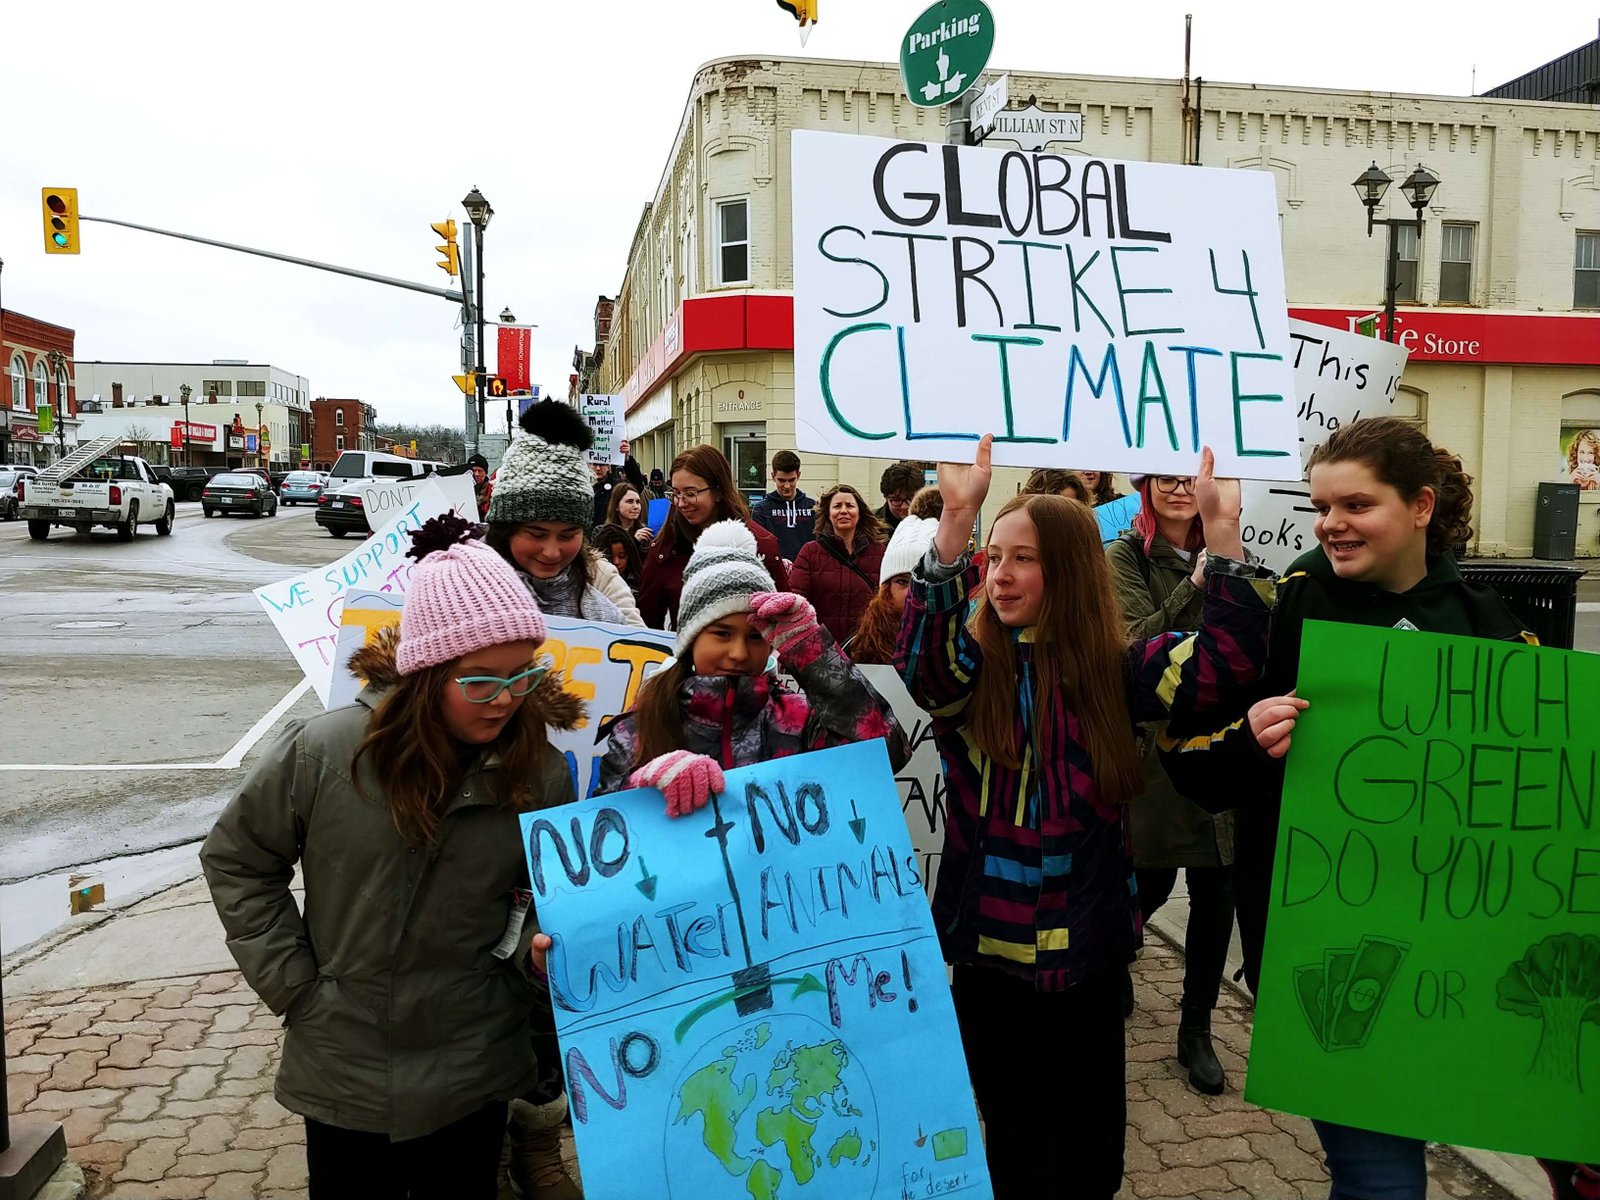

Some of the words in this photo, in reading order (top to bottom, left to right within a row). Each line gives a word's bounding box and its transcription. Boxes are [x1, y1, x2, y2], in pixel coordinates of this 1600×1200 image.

[908, 12, 981, 55] Parking
[975, 94, 992, 121] KENT
[996, 117, 1046, 134] ILLIAM
[1049, 119, 1066, 135] ST
[1069, 119, 1079, 135] N
[873, 142, 1172, 244] GLOBAL
[818, 224, 1185, 339] STRIKE
[1208, 248, 1266, 350] 4
[1289, 333, 1370, 390] This
[1424, 332, 1480, 355] Store
[587, 395, 611, 406] Rural
[717, 401, 762, 412] ENTRANCE
[820, 321, 1291, 457] CLIMATE
[589, 451, 612, 463] Policy!
[365, 485, 416, 514] DON'T
[1239, 508, 1303, 551] ooks
[260, 581, 314, 613] WE
[324, 501, 425, 596] SUPPORT
[1377, 640, 1570, 739] WHICH
[1333, 734, 1597, 833] GREEN
[744, 780, 831, 854] NO
[528, 807, 630, 897] NO
[1282, 826, 1379, 908] DO
[1411, 834, 1514, 922] YOU
[825, 949, 920, 1029] Me!
[1414, 968, 1466, 1020] OR
[565, 1030, 661, 1124] NO
[901, 1161, 924, 1187] for
[926, 1171, 969, 1195] desert
